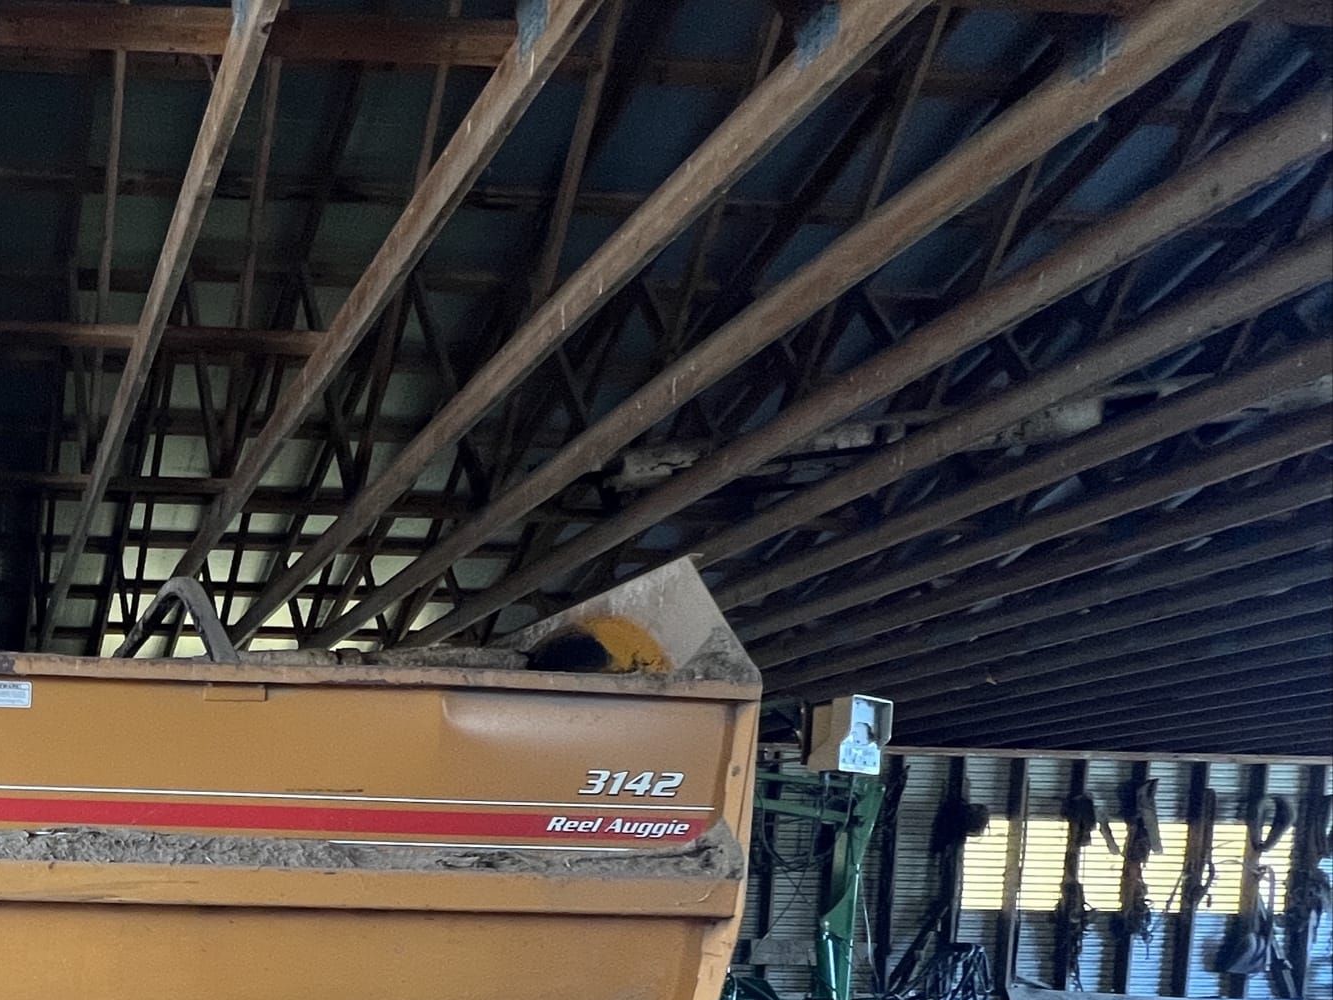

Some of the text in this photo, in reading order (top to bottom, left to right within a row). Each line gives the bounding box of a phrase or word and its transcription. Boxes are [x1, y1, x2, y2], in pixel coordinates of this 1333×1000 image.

[578, 770, 685, 797] 3142
[546, 817, 690, 839] Reel Auggie
